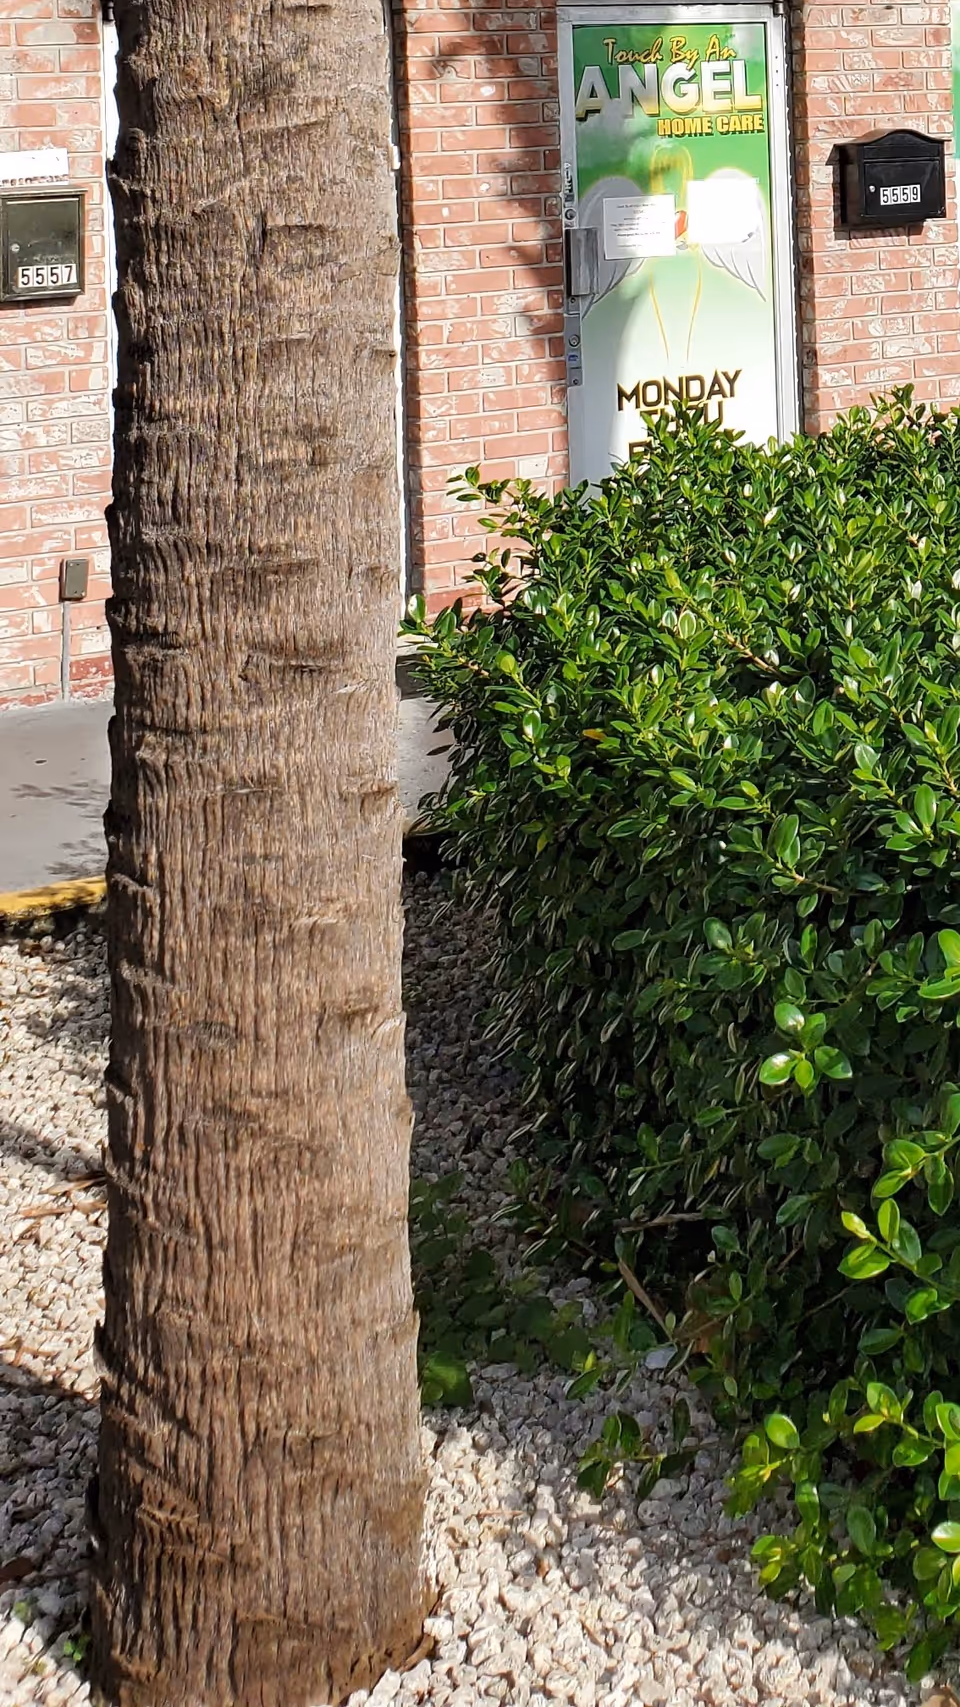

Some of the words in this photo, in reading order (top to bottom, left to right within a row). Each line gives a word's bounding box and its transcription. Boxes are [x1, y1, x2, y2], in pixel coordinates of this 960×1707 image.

[603, 37, 664, 66] Touch
[670, 35, 699, 71] By
[705, 34, 737, 61] An
[575, 59, 763, 122] ANGEL
[657, 116, 713, 138] HOME
[716, 113, 765, 136] CARE
[881, 185, 921, 205] 5559
[20, 265, 73, 286] 5557
[617, 368, 742, 412] MONDAY
